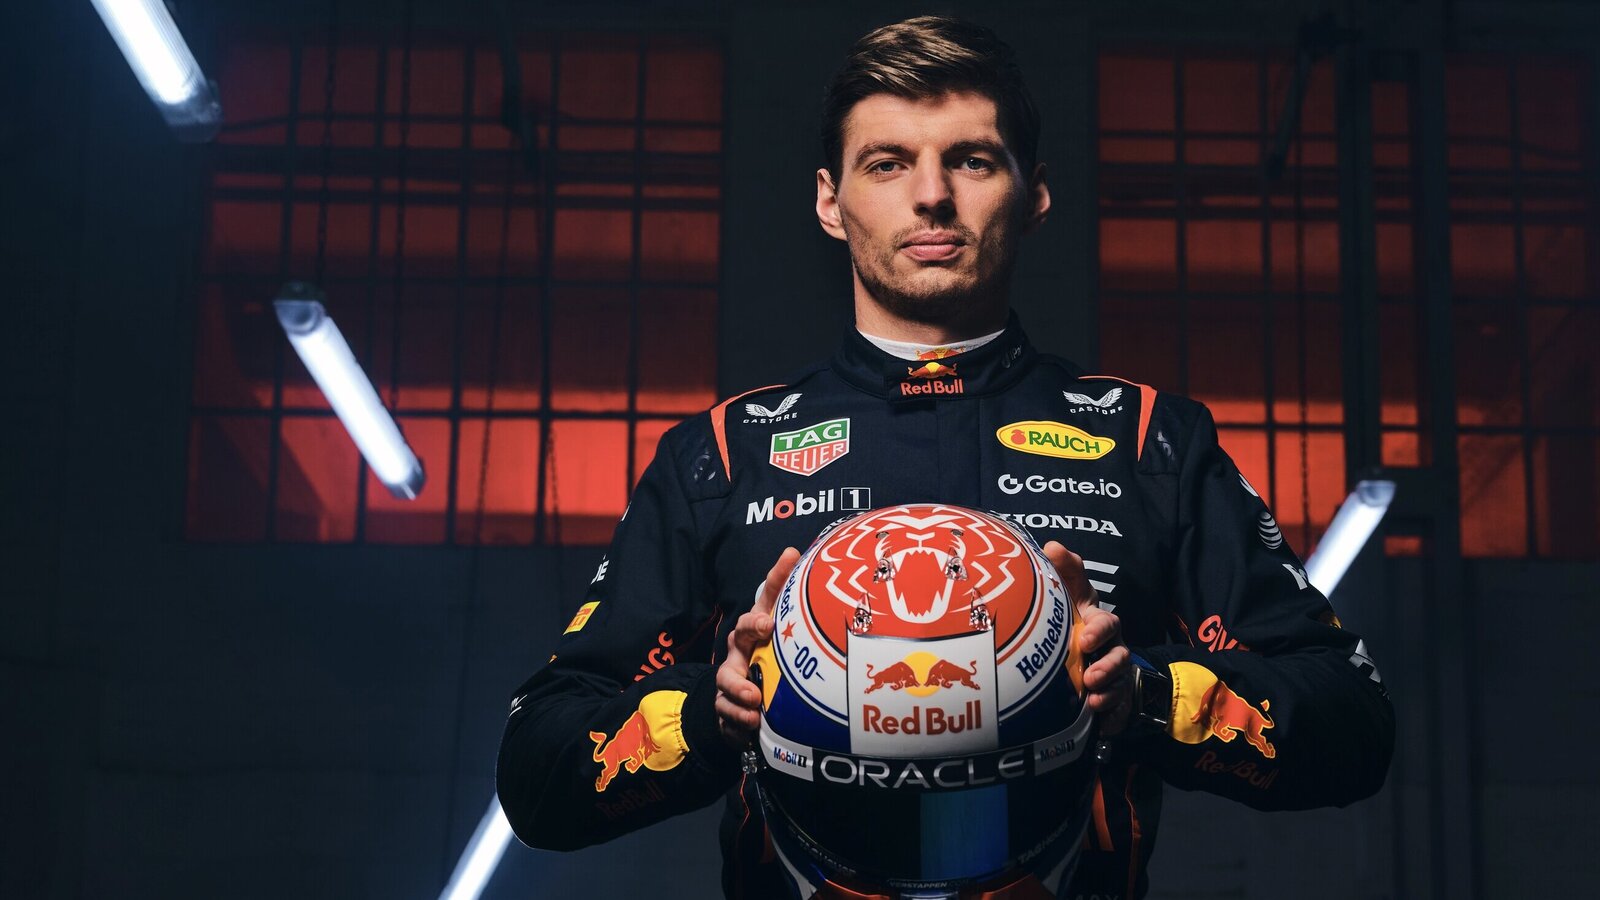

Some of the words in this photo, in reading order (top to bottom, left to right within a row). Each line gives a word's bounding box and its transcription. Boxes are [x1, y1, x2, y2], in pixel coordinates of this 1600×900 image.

[900, 380, 932, 396] Red
[933, 378, 964, 395] Bull
[743, 412, 798, 424] CASTORE
[1069, 405, 1123, 415] CASTORE
[779, 423, 843, 449] TAG
[1028, 430, 1101, 454] RAUCH
[775, 442, 844, 472] HEUER
[1025, 475, 1122, 498] Gate.io
[745, 489, 834, 525] Mobil
[1015, 597, 1065, 683] Heineken
[863, 704, 921, 735] Red
[926, 700, 982, 735] Bull
[773, 747, 798, 765] Mobil
[1040, 743, 1066, 762] Mobil
[820, 750, 1026, 789] ORACLE
[1233, 761, 1281, 791] Bull
